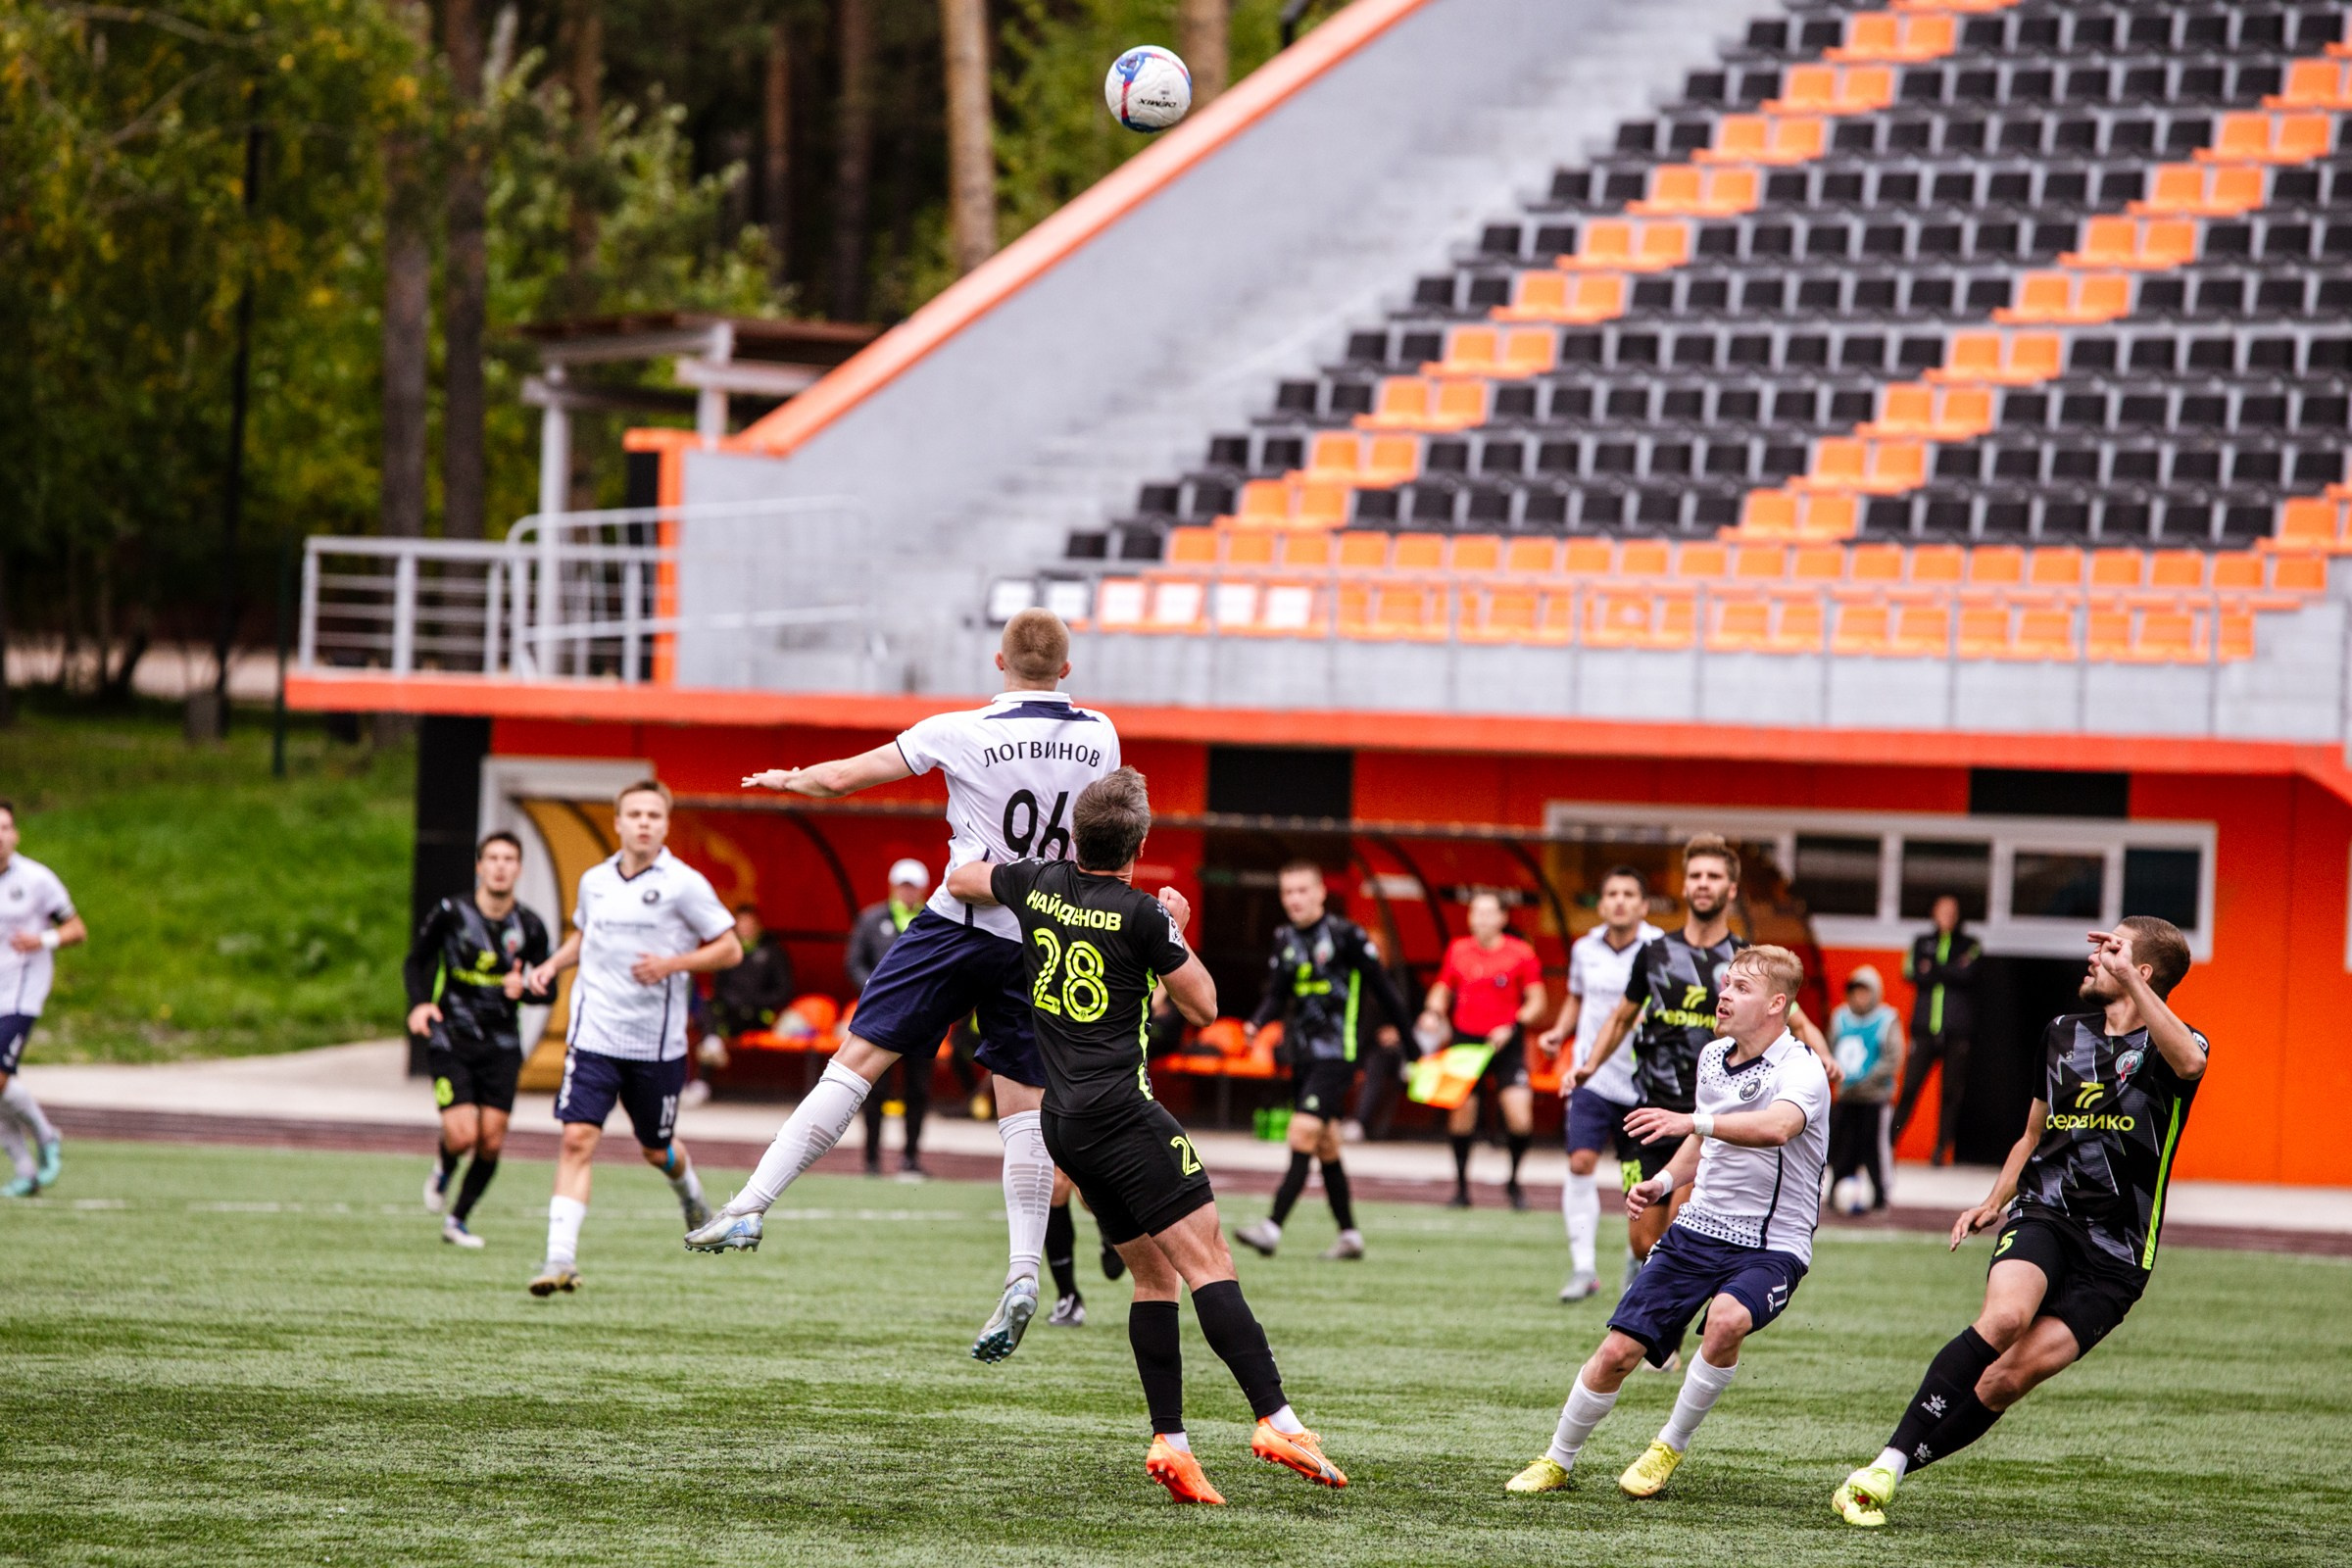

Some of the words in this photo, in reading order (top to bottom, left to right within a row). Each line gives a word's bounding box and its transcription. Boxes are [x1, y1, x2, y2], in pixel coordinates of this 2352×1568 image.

[983, 741, 1101, 768] ЛОГВИНОВ
[1032, 927, 1109, 1023] 28
[1169, 1132, 1204, 1176] 2
[1993, 1228, 2019, 1257] 5
